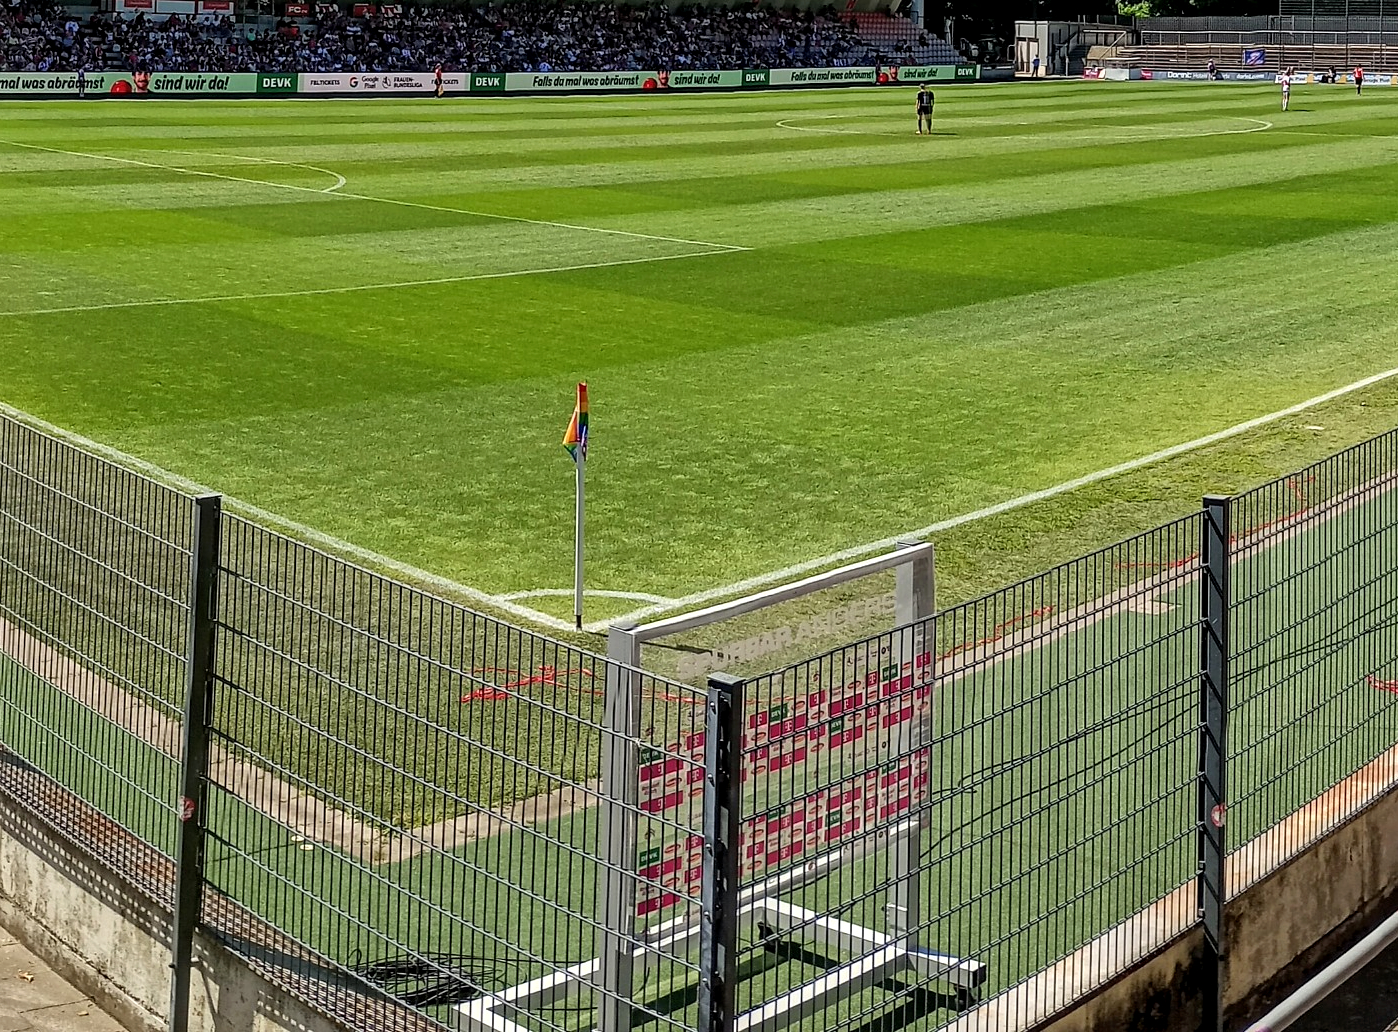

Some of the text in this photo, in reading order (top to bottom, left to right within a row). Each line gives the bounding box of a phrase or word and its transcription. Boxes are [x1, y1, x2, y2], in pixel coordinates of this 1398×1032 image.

[745, 72, 766, 82] DEVK
[957, 68, 974, 76] DEVK
[22, 78, 45, 89] was
[154, 75, 229, 90] sind wir da!
[262, 77, 292, 88] DEVK
[475, 77, 500, 87] DEVK
[533, 75, 552, 87] Falls
[565, 75, 581, 86] mal
[674, 73, 692, 85] sind
[694, 74, 707, 85] wir
